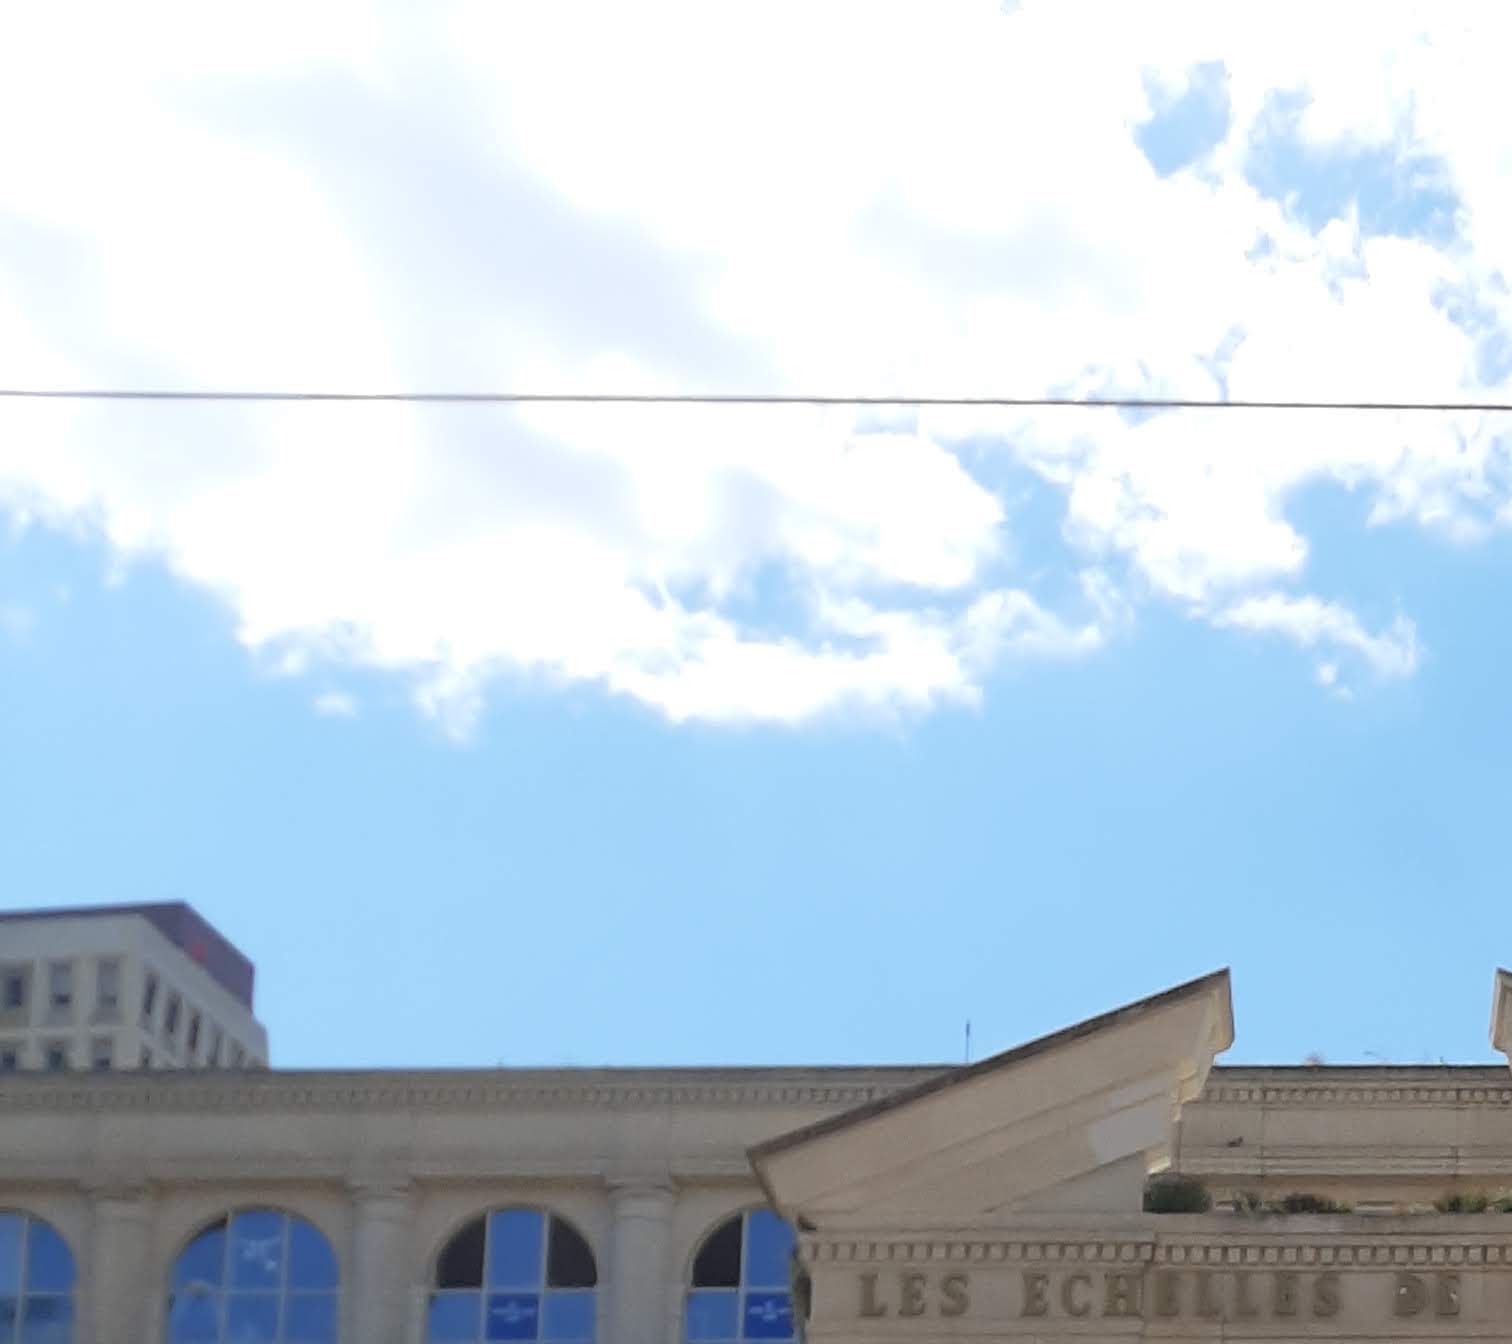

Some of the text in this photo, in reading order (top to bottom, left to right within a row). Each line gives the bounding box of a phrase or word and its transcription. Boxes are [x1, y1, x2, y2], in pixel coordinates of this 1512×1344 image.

[857, 1271, 970, 1318] LES
[1020, 1269, 1342, 1318] ECHELLES
[1392, 1270, 1461, 1317] DE
